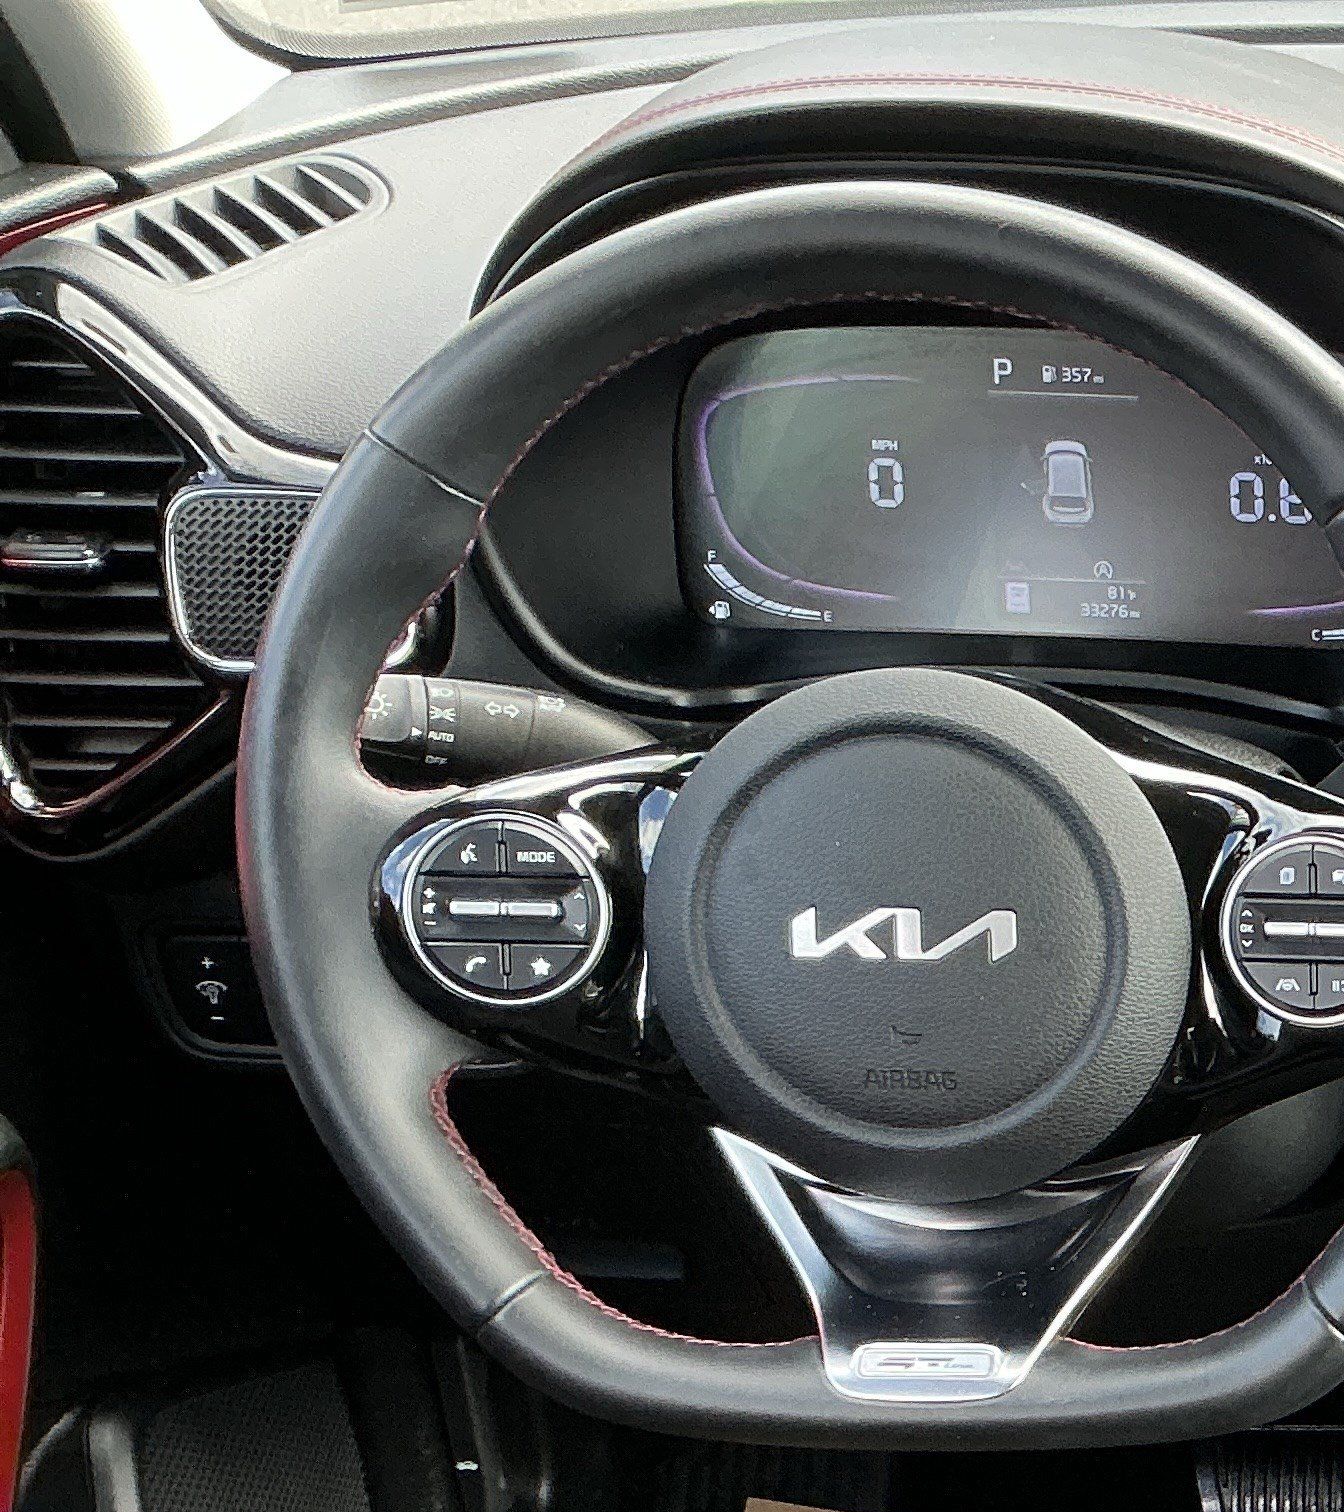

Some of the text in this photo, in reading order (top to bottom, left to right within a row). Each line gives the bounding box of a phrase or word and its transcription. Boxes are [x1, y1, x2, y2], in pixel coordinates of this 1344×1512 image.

[993, 358, 1013, 385] P
[1061, 367, 1092, 383] 357
[871, 438, 899, 451] MPH
[868, 457, 905, 509] 0
[707, 550, 717, 562] F
[823, 610, 834, 623] E
[428, 730, 455, 743] AUTO
[516, 851, 556, 863] MODE
[863, 1067, 957, 1090] AIRBAG
